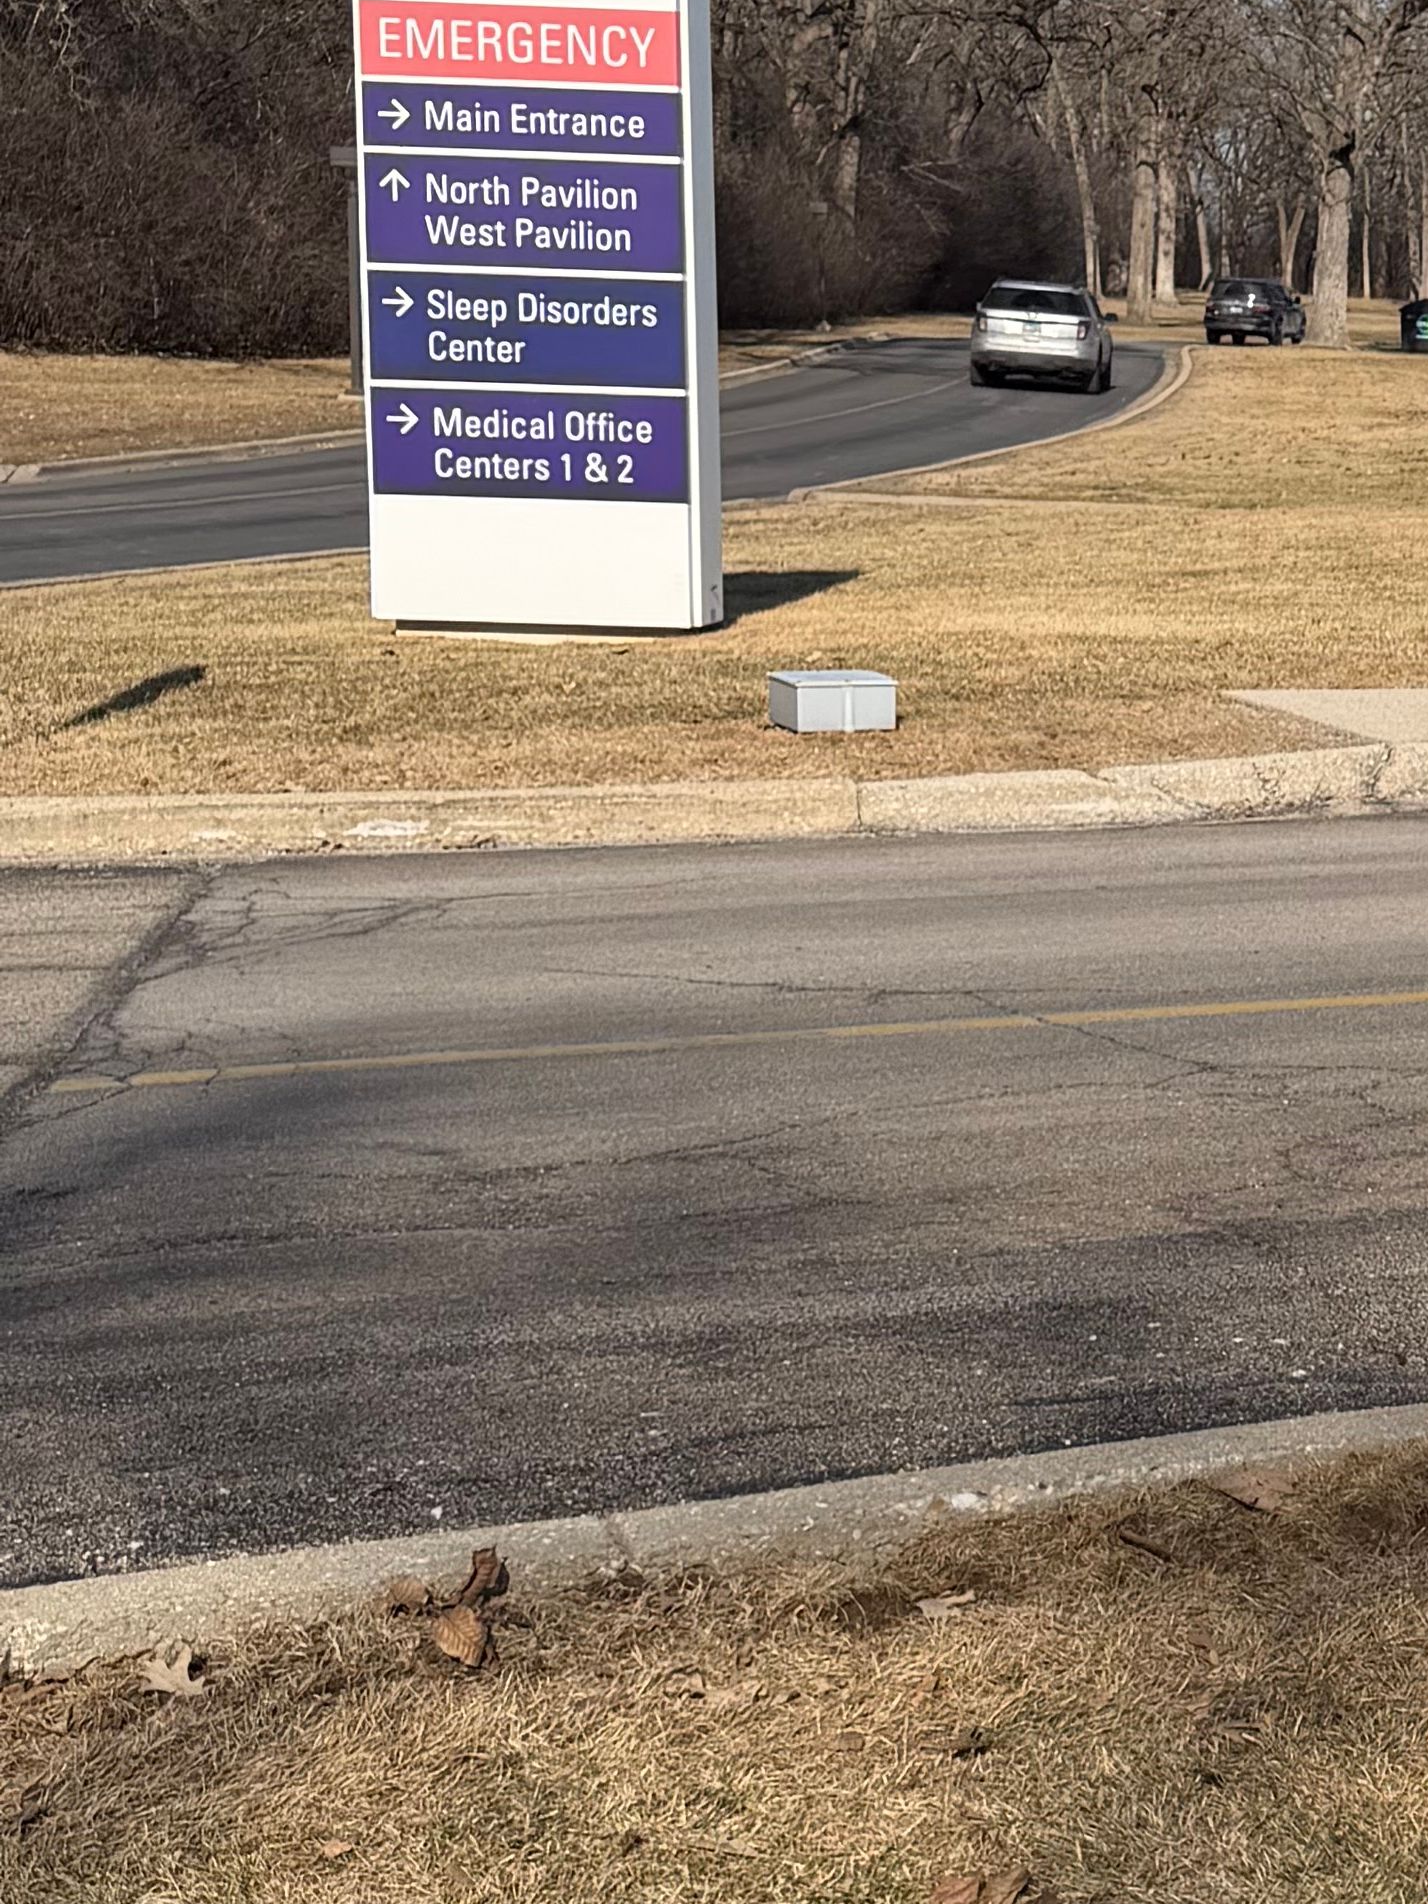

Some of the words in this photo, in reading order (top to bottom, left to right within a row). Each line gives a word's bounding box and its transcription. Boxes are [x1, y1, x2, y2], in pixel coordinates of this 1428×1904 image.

[378, 16, 656, 68] EMERGENCY
[424, 100, 500, 133] Main
[510, 103, 645, 138] Entrance
[425, 172, 510, 206] North
[521, 176, 637, 211] Pavilion
[424, 214, 507, 247] West
[515, 217, 631, 252] Pavilion
[426, 288, 508, 328] Sleep
[518, 292, 658, 328] Disorders
[428, 330, 526, 363] Center
[433, 406, 555, 440] Medical
[565, 410, 653, 444] Office
[434, 447, 550, 481] Centers
[560, 453, 571, 482] 1
[584, 452, 609, 483] &
[616, 454, 634, 484] 2
